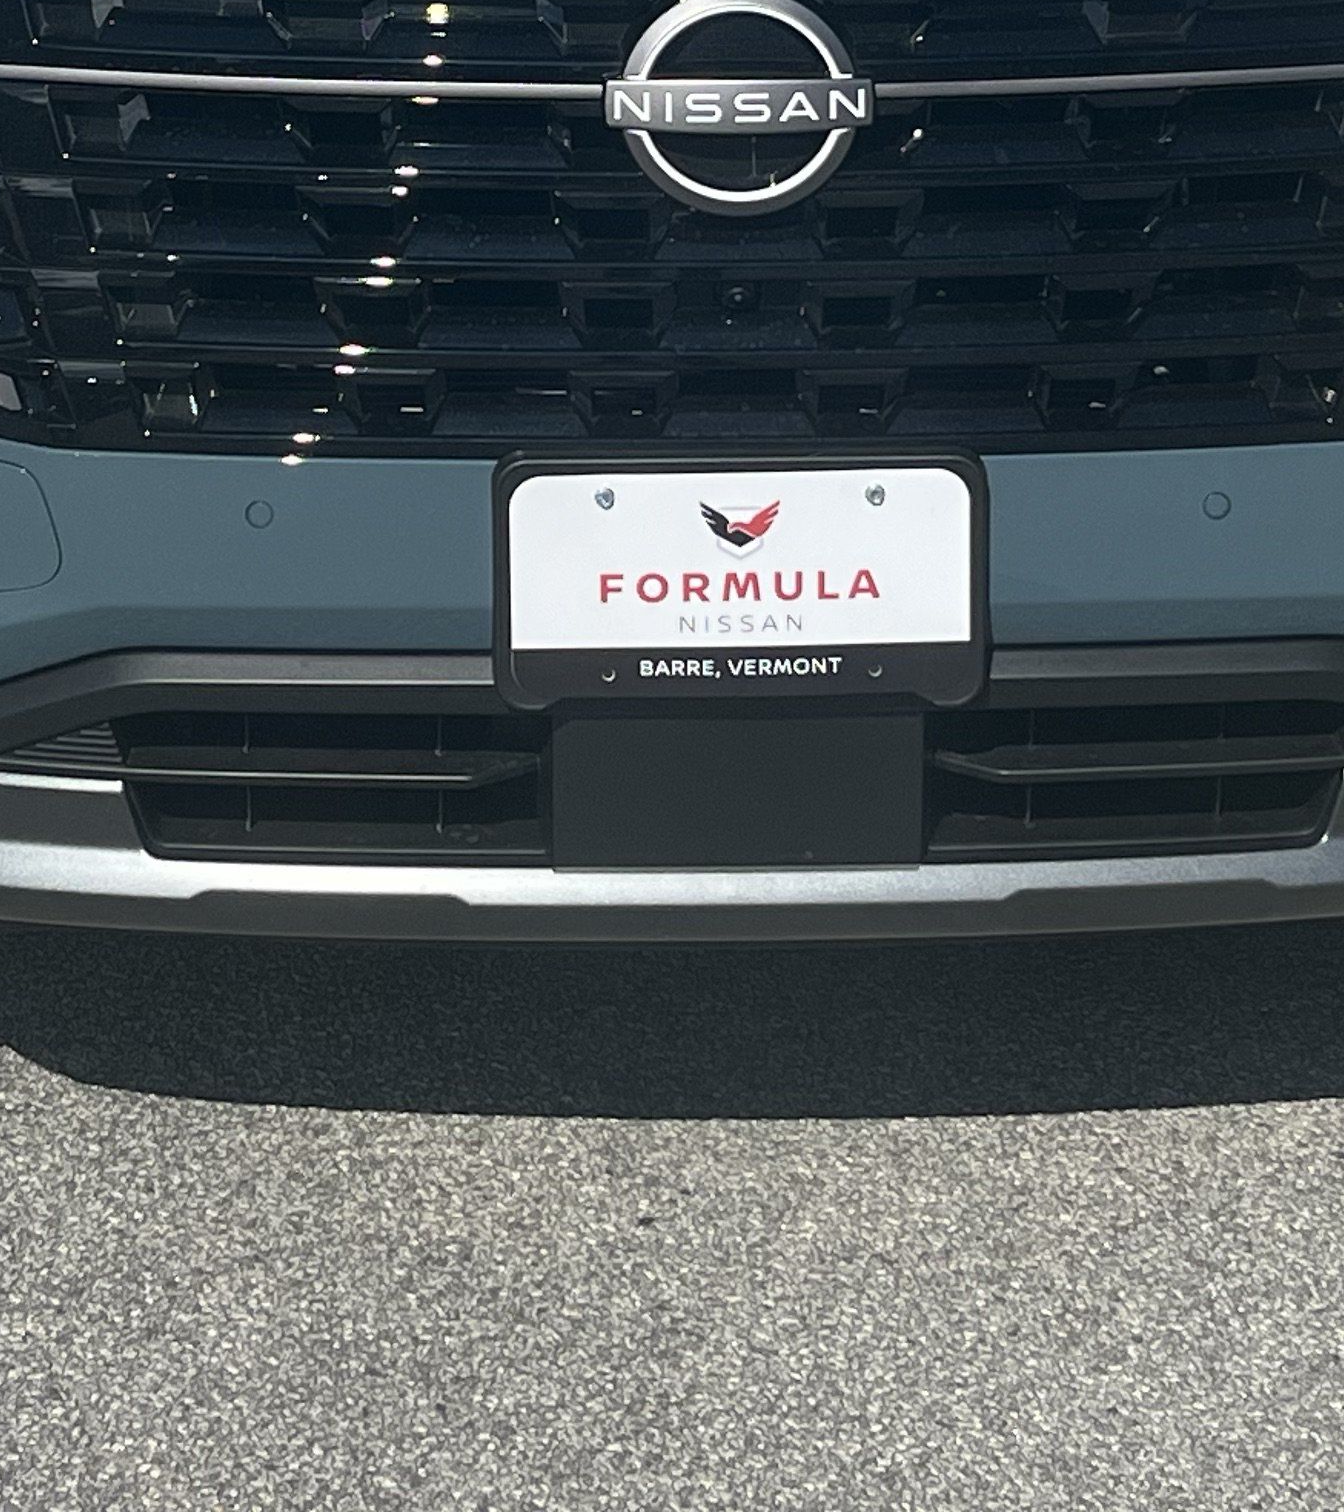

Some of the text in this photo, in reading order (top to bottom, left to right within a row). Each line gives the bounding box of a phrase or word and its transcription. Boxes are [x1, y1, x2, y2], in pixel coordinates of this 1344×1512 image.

[612, 88, 867, 124] NISSAN
[599, 569, 881, 603] FORMULA
[678, 614, 803, 634] NISSAN
[638, 656, 843, 679] BARRE, VERMONT
